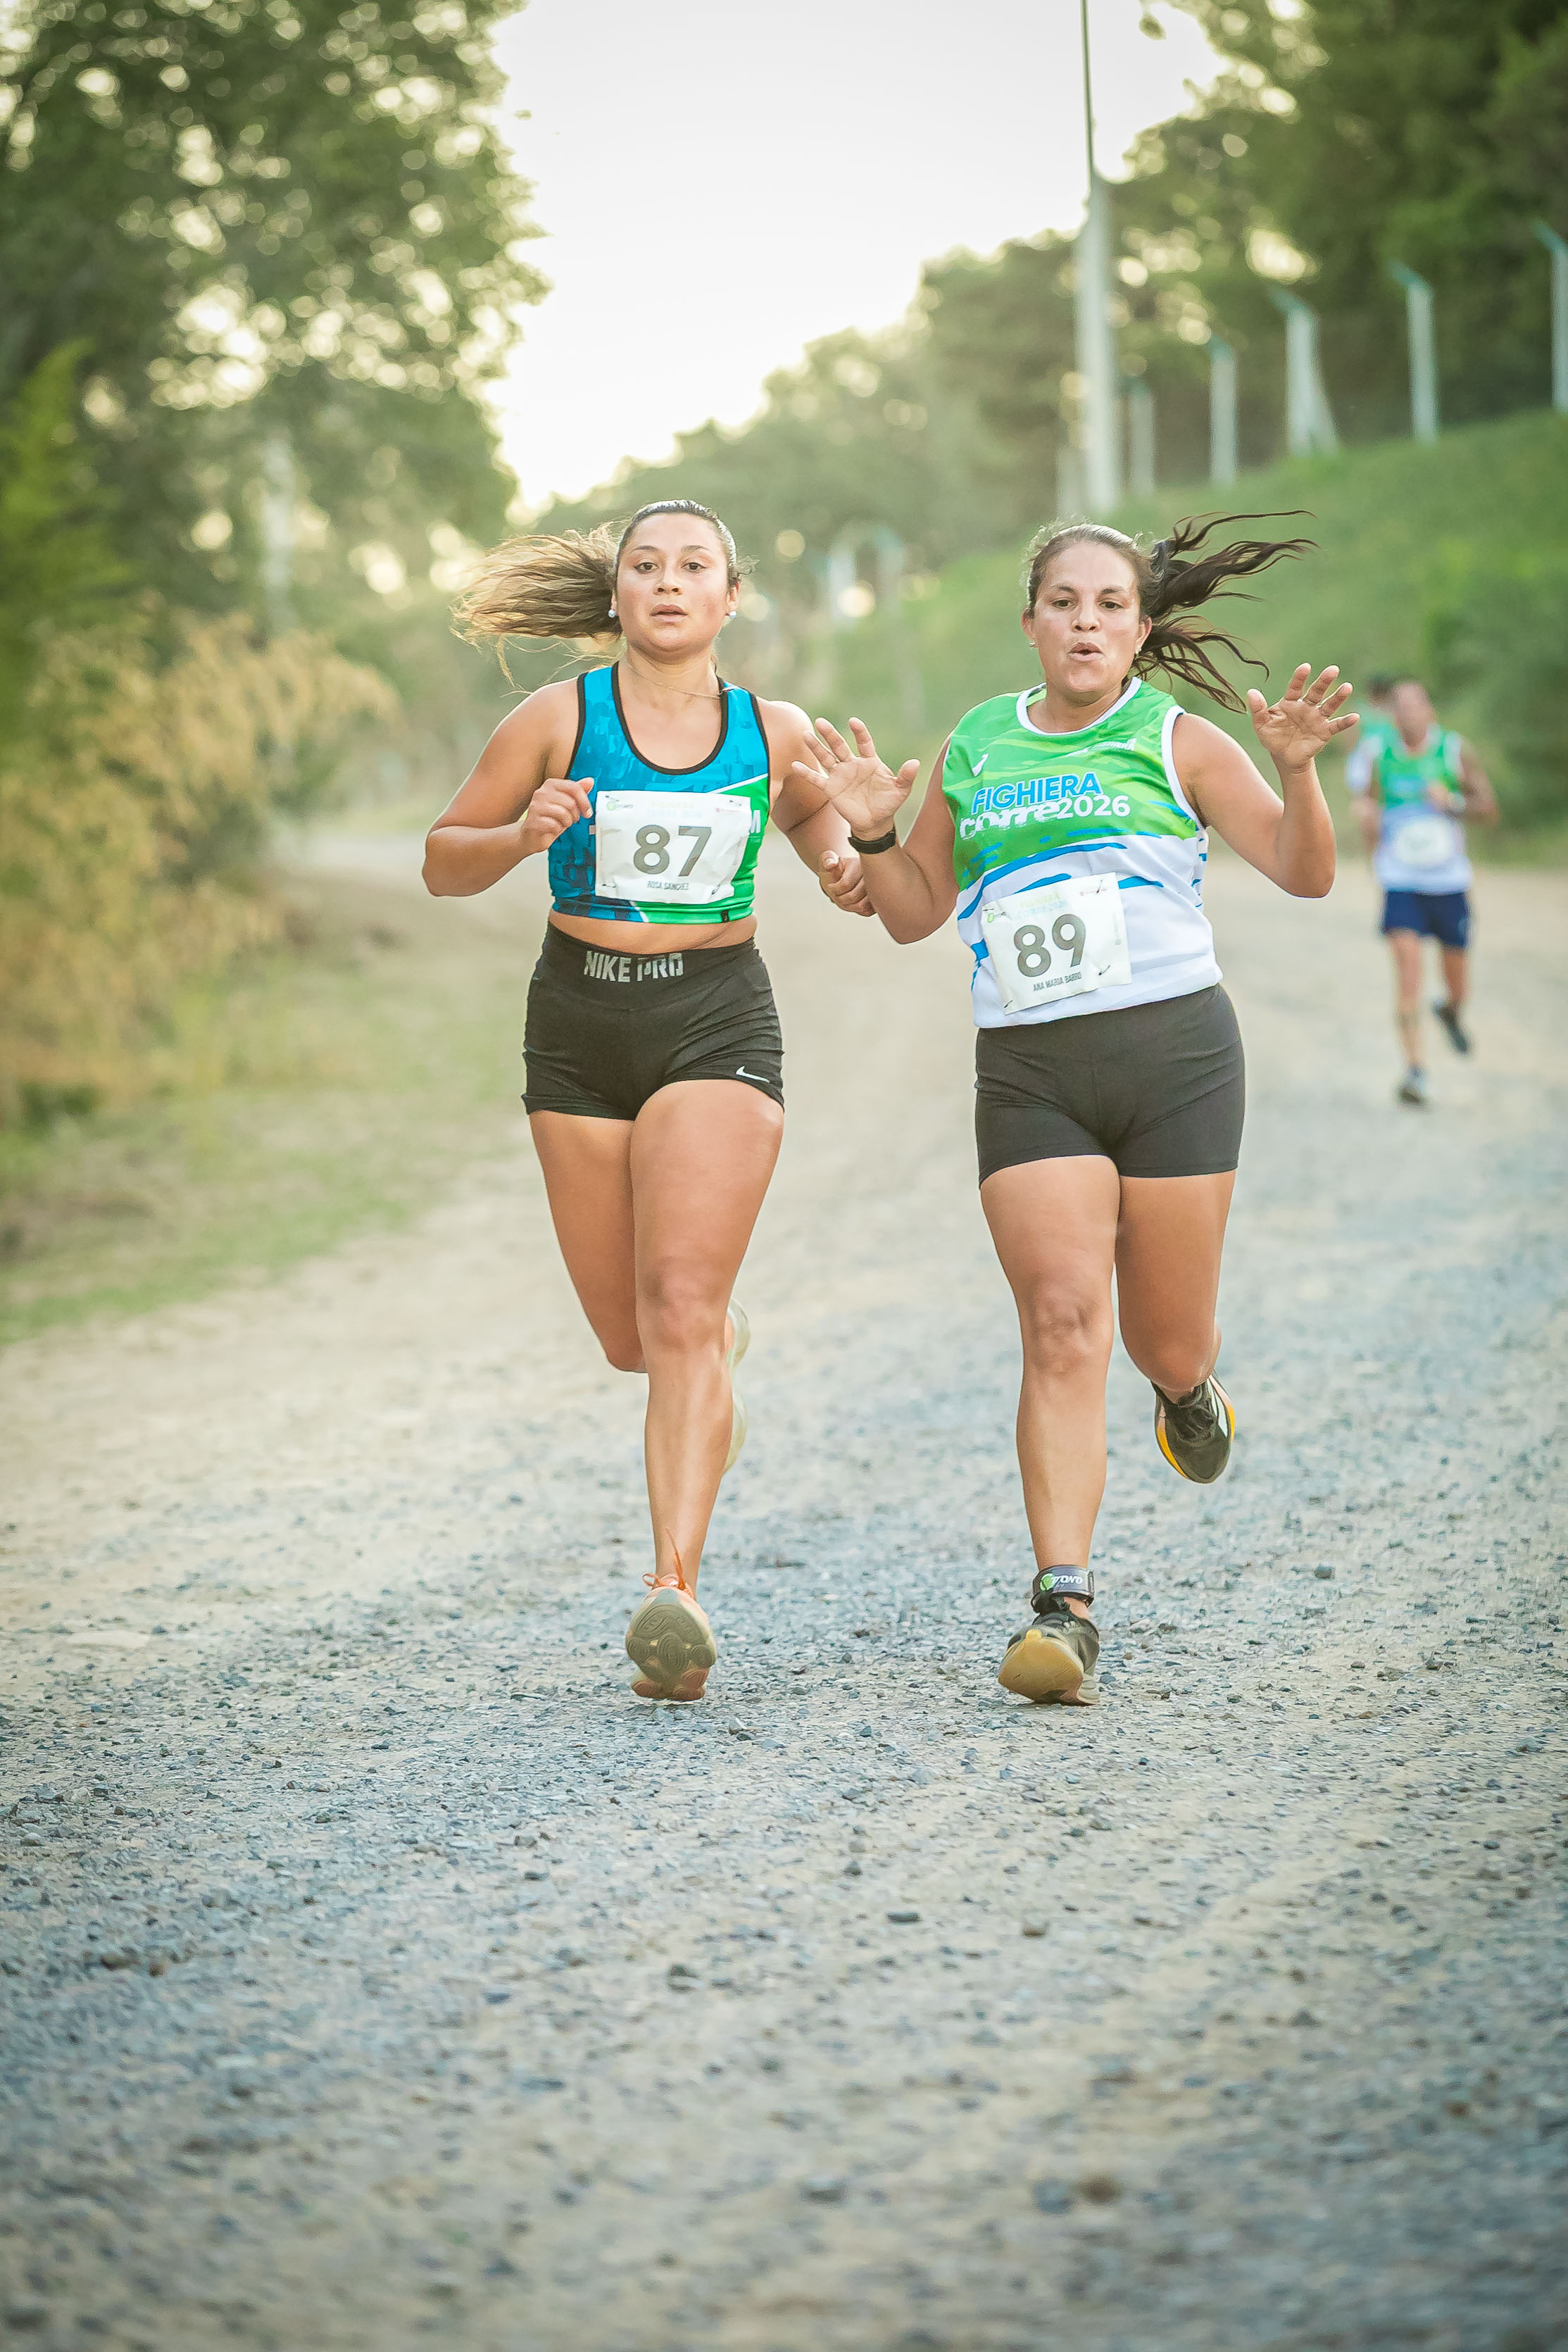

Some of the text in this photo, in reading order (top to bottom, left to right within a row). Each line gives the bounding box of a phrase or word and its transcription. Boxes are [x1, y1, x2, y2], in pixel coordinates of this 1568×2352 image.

[971, 772, 1103, 815] FIGHIERA
[633, 824, 713, 877] 87
[583, 950, 684, 983] NIKE PRO
[1013, 913, 1086, 977] 89
